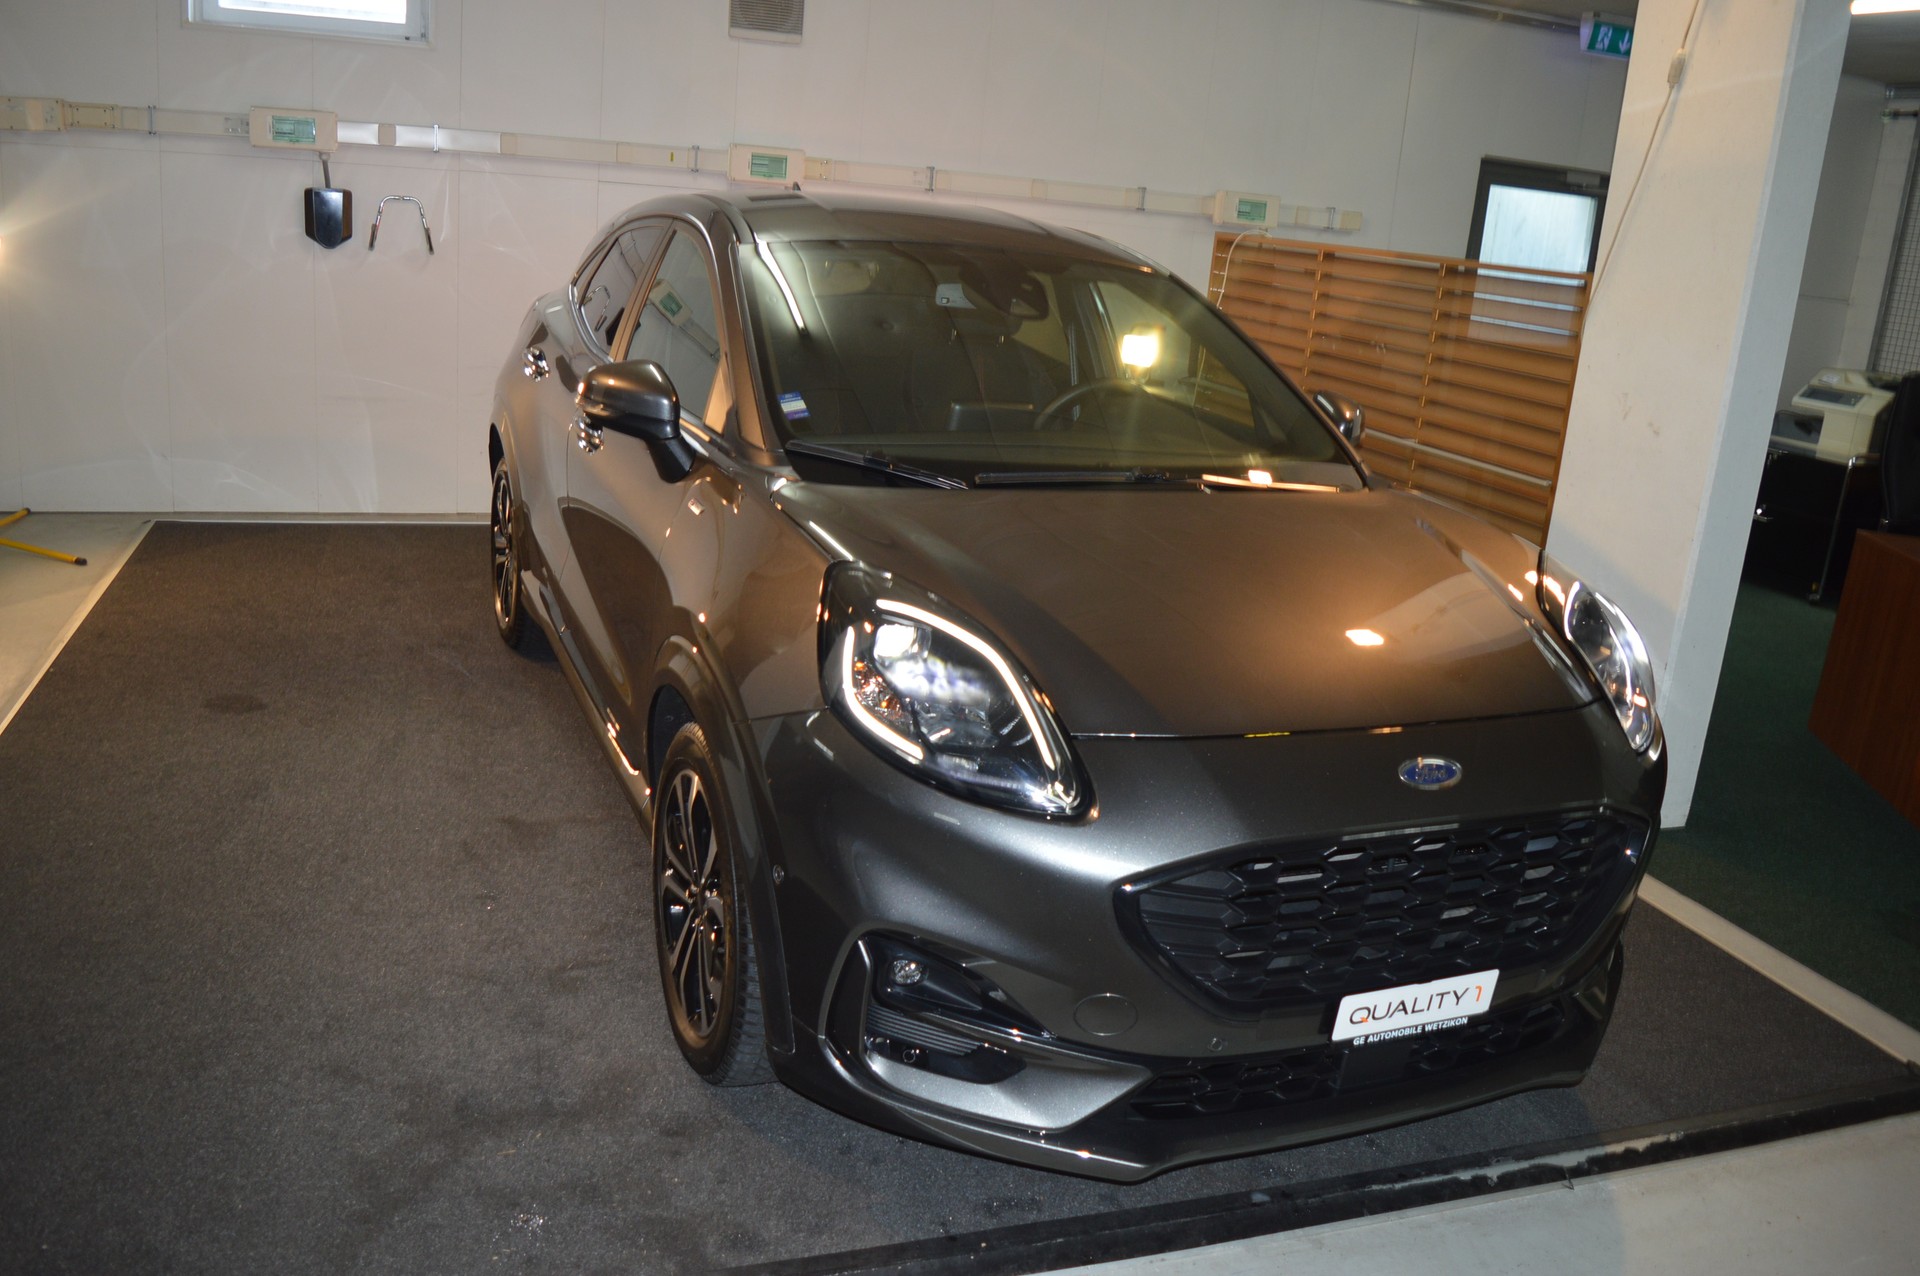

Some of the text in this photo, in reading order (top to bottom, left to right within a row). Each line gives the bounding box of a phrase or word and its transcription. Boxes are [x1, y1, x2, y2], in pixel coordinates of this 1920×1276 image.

[1349, 985, 1483, 1025] QUALITY 1
[1367, 1026, 1422, 1043] AUTOMOBILE
[1424, 1016, 1468, 1032] WETZIKON
